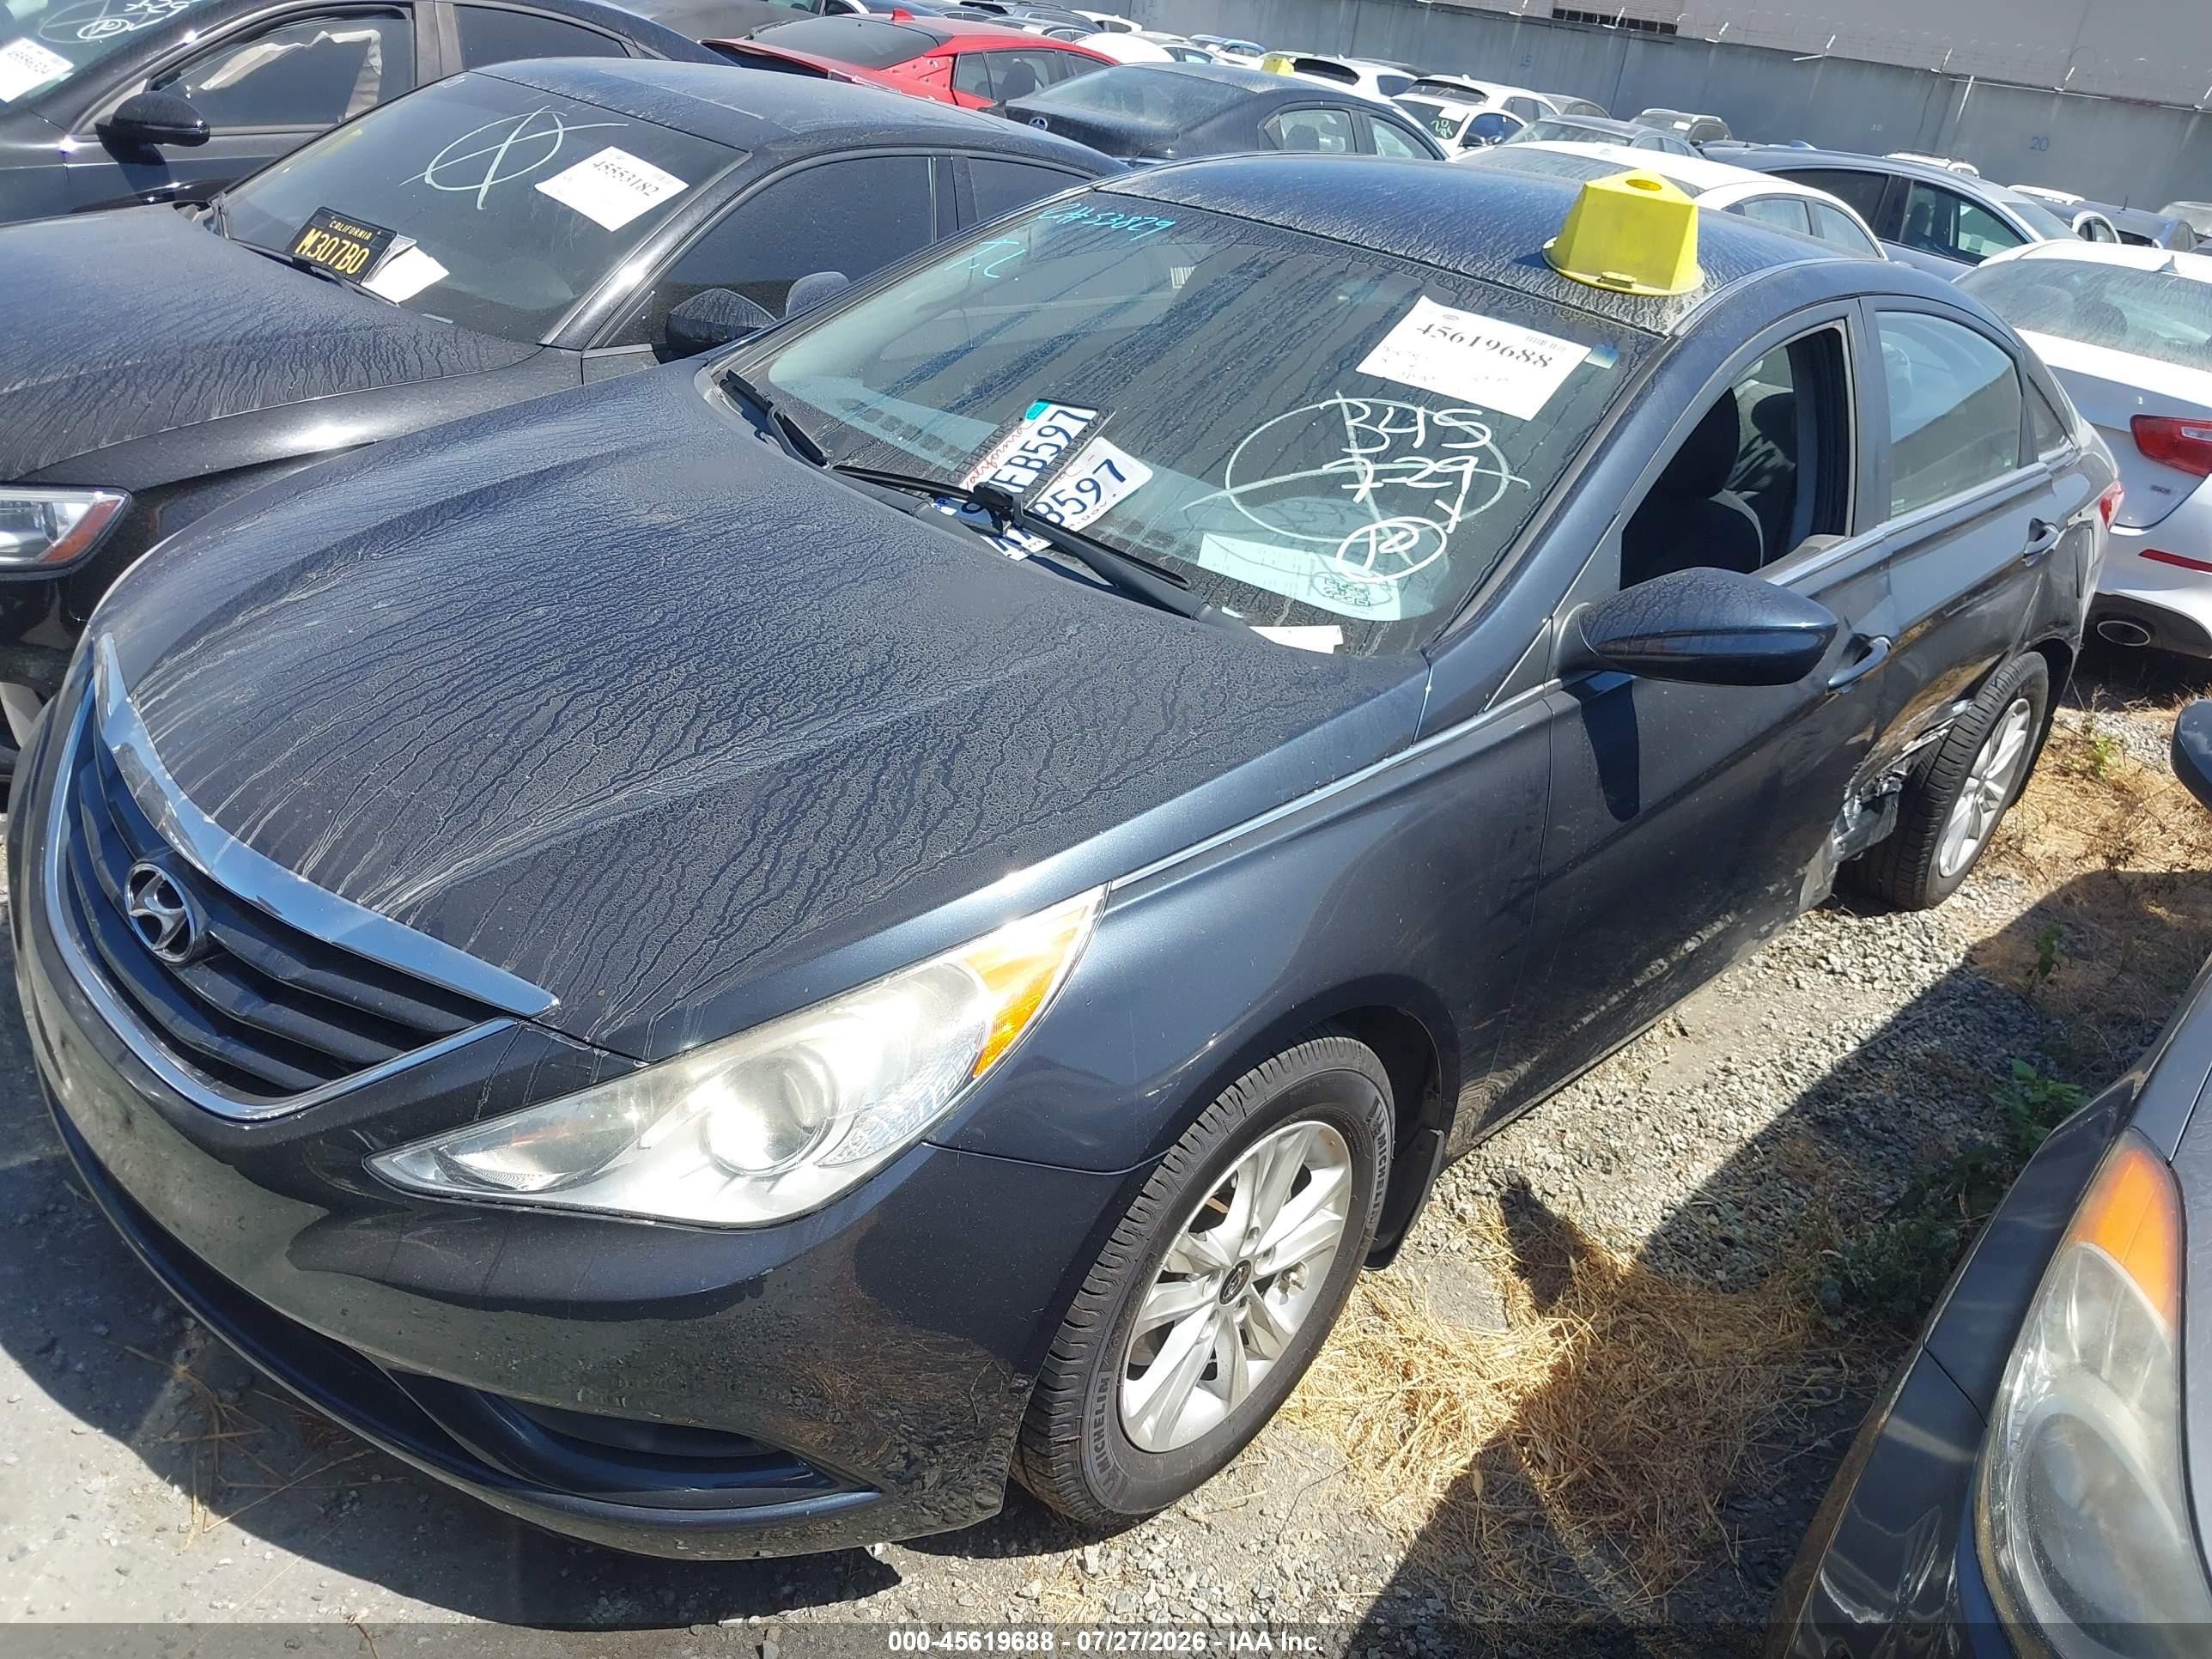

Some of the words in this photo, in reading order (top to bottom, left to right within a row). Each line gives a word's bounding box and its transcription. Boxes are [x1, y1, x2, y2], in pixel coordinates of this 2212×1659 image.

[2030, 137, 2051, 152] 20
[592, 160, 659, 197] 45553182
[328, 220, 373, 241] CALIFORNIA
[1416, 323, 1553, 368] 45619688
[989, 410, 1092, 491] FB597
[1032, 458, 1127, 526] B597
[1089, 1376, 1112, 1475] MICHELIN
